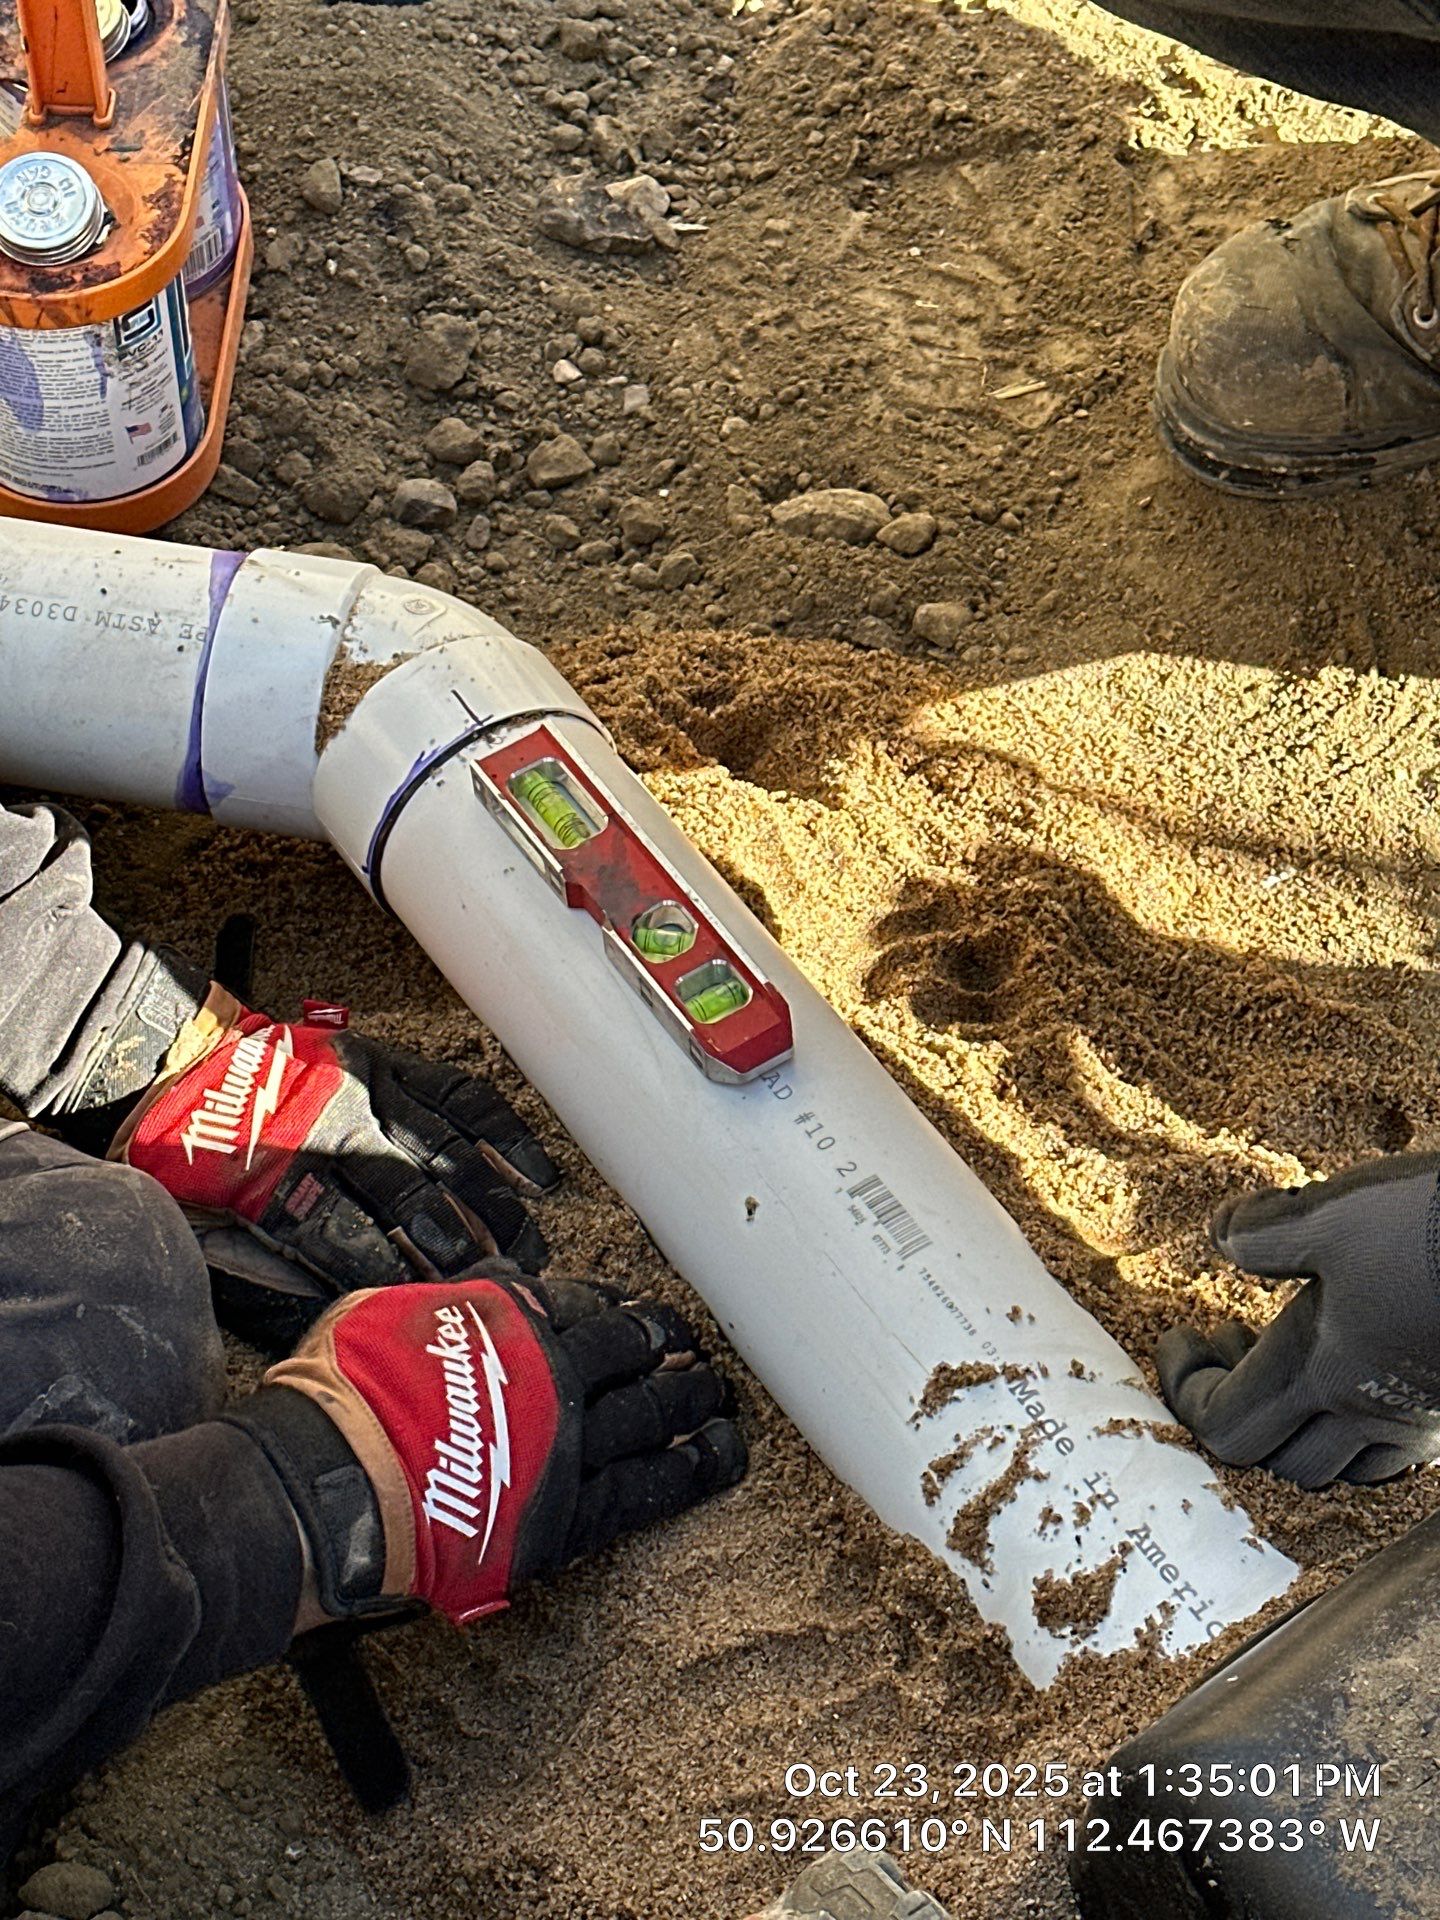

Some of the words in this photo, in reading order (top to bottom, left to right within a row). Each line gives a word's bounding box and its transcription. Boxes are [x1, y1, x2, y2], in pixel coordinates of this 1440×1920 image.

[94, 610, 163, 636] ASTM
[180, 1024, 276, 1166] Milwau
[793, 1111, 836, 1151] #10
[836, 1161, 858, 1178] 2
[422, 1305, 484, 1538] Milwaukee
[1008, 1379, 1075, 1457] Made
[1083, 1472, 1120, 1511] in
[1125, 1522, 1224, 1640] Americ
